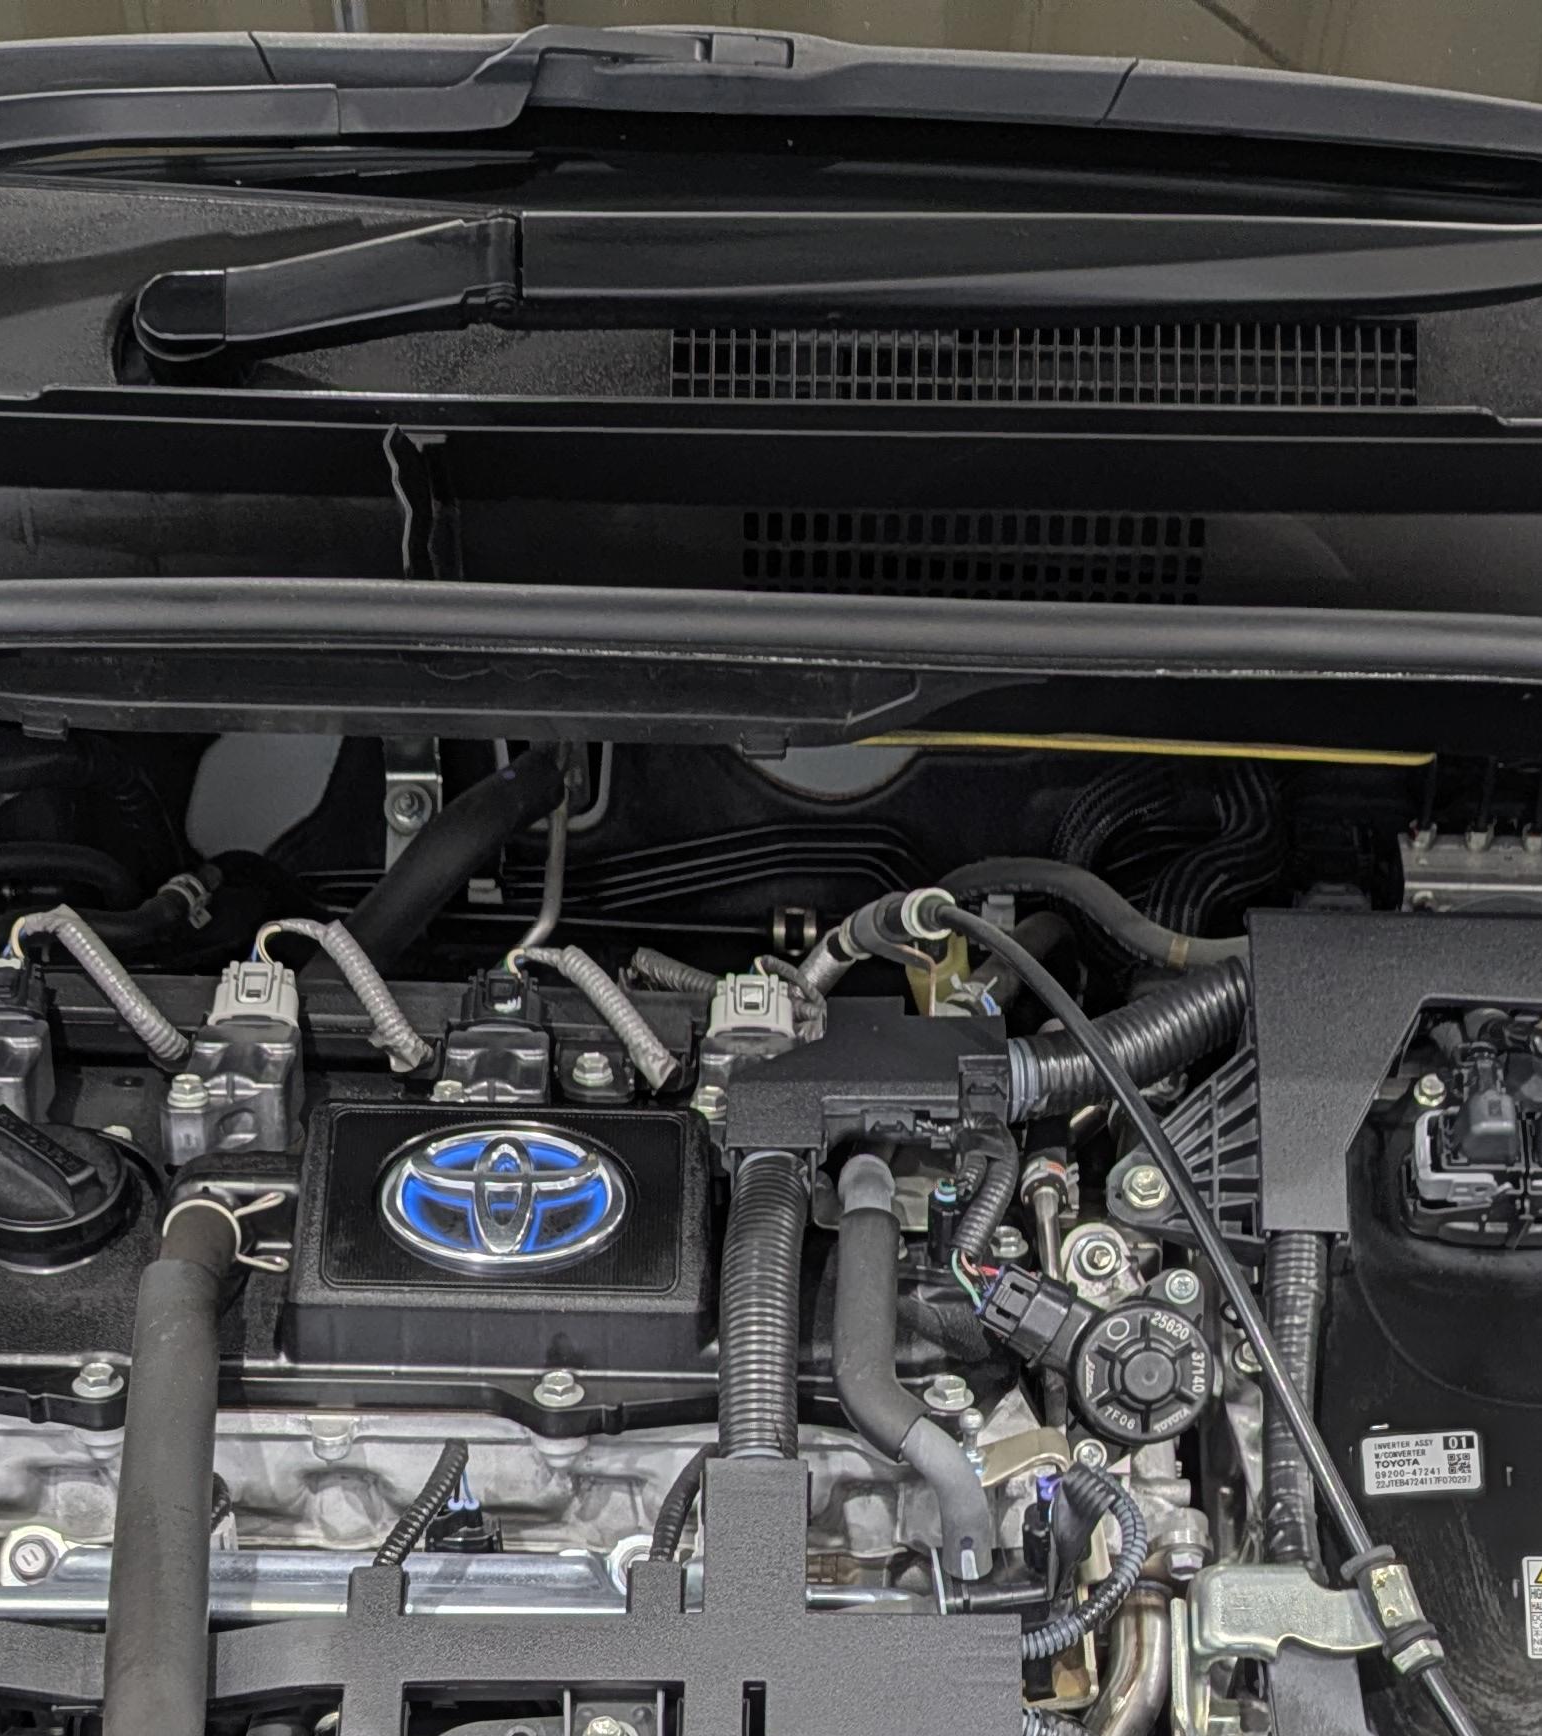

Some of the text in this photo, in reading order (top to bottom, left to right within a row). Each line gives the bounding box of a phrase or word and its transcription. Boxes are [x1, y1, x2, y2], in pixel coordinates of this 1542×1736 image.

[1151, 1311, 1190, 1340] 25620
[1191, 1351, 1206, 1393] 37140
[1104, 1405, 1136, 1430] 7F06
[1153, 1407, 1192, 1433] TOYOTA
[1374, 1436, 1467, 1450] INVERTER ASSY 01
[1374, 1449, 1426, 1459] W/CONVERTER
[1375, 1459, 1421, 1469] TOYOTA
[1375, 1467, 1441, 1479] G9200-47241
